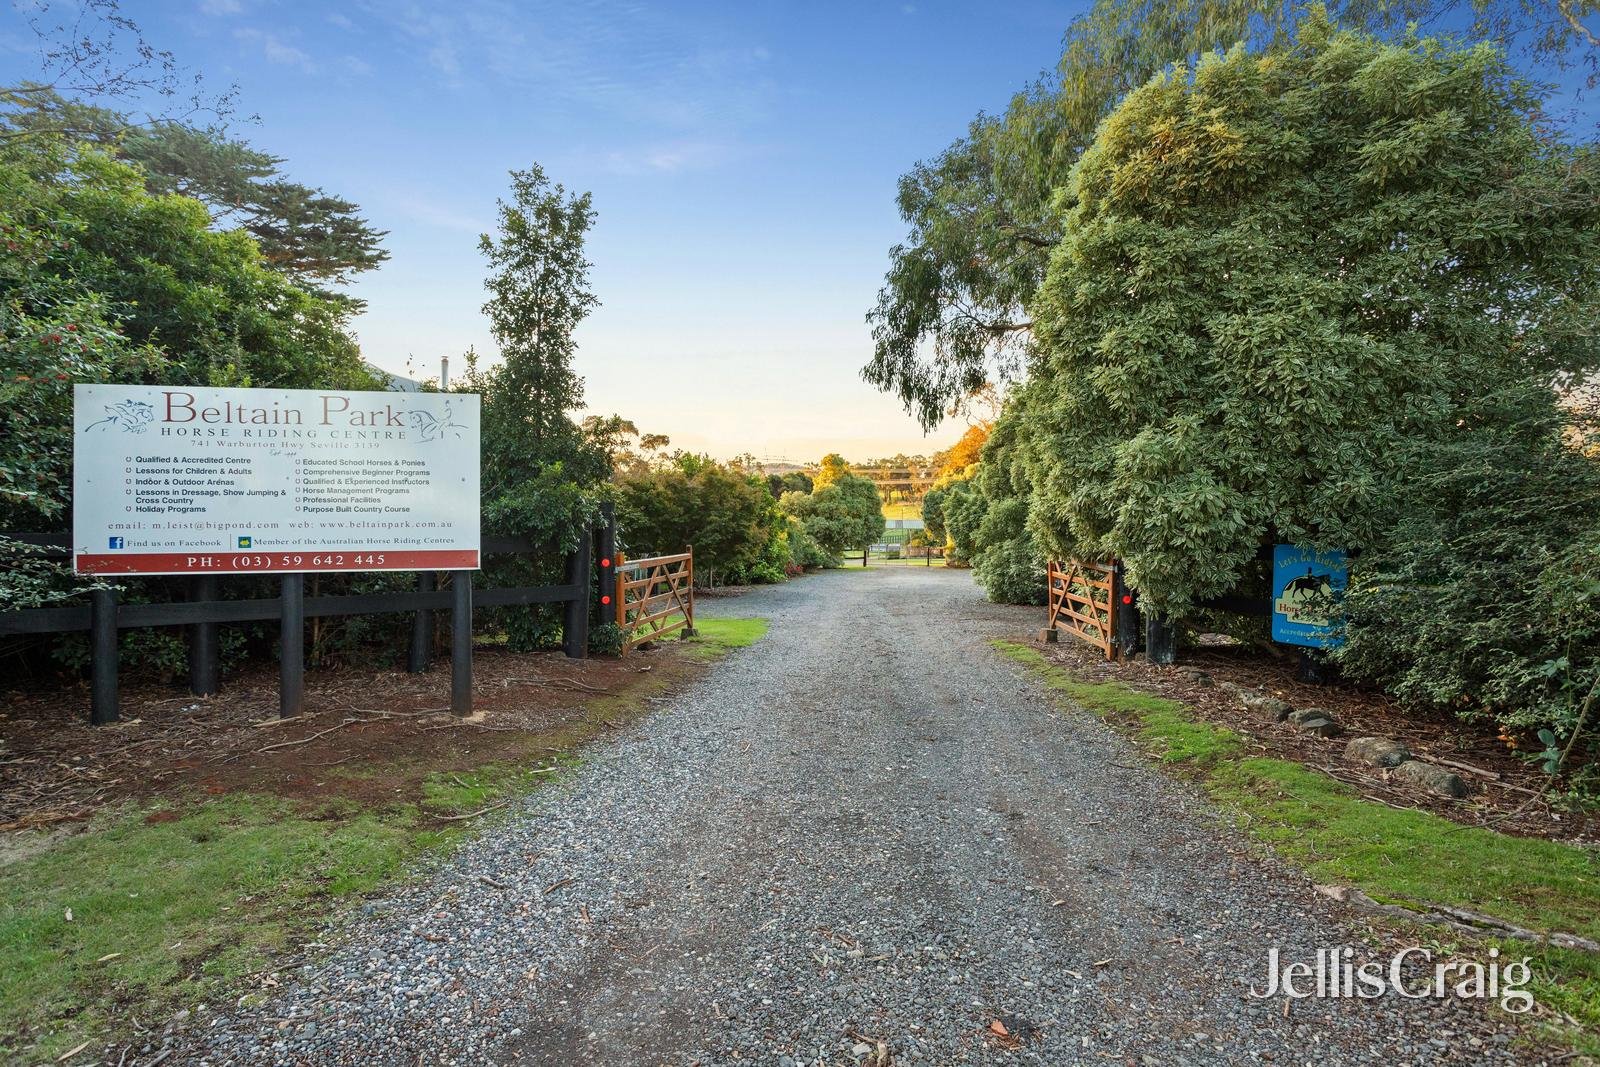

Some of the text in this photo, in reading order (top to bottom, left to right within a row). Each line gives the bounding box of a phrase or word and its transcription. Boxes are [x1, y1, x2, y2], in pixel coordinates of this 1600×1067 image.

[161, 391, 405, 427] Beltain Park
[161, 427, 407, 440] HORSE RIDING CENTRE
[216, 440, 276, 448] Warburton
[281, 441, 304, 449] Hwy
[310, 441, 350, 449] Seville
[354, 441, 380, 449] 3139
[135, 456, 171, 464] Qualified
[303, 468, 431, 478] Comprehensive Beginner Programs
[135, 478, 162, 486] Indoor
[344, 478, 389, 487] Experienced
[181, 489, 221, 497] Dressage,
[246, 489, 279, 497] Jumping
[326, 488, 373, 496] Management
[375, 488, 410, 496] Programs
[162, 497, 194, 505] Country
[135, 506, 207, 514] Holiday Programs
[303, 506, 334, 514] Purpose
[353, 506, 383, 514] Country
[108, 521, 452, 531] email: m.leist@bigpond.com web: www.beltainpark.com.au
[127, 539, 148, 547] Find
[179, 539, 222, 547] Facebook
[254, 538, 289, 546] Member
[319, 537, 364, 545] Australian
[394, 537, 422, 545] Riding
[187, 554, 385, 569] PH: (03) 59 642 445
